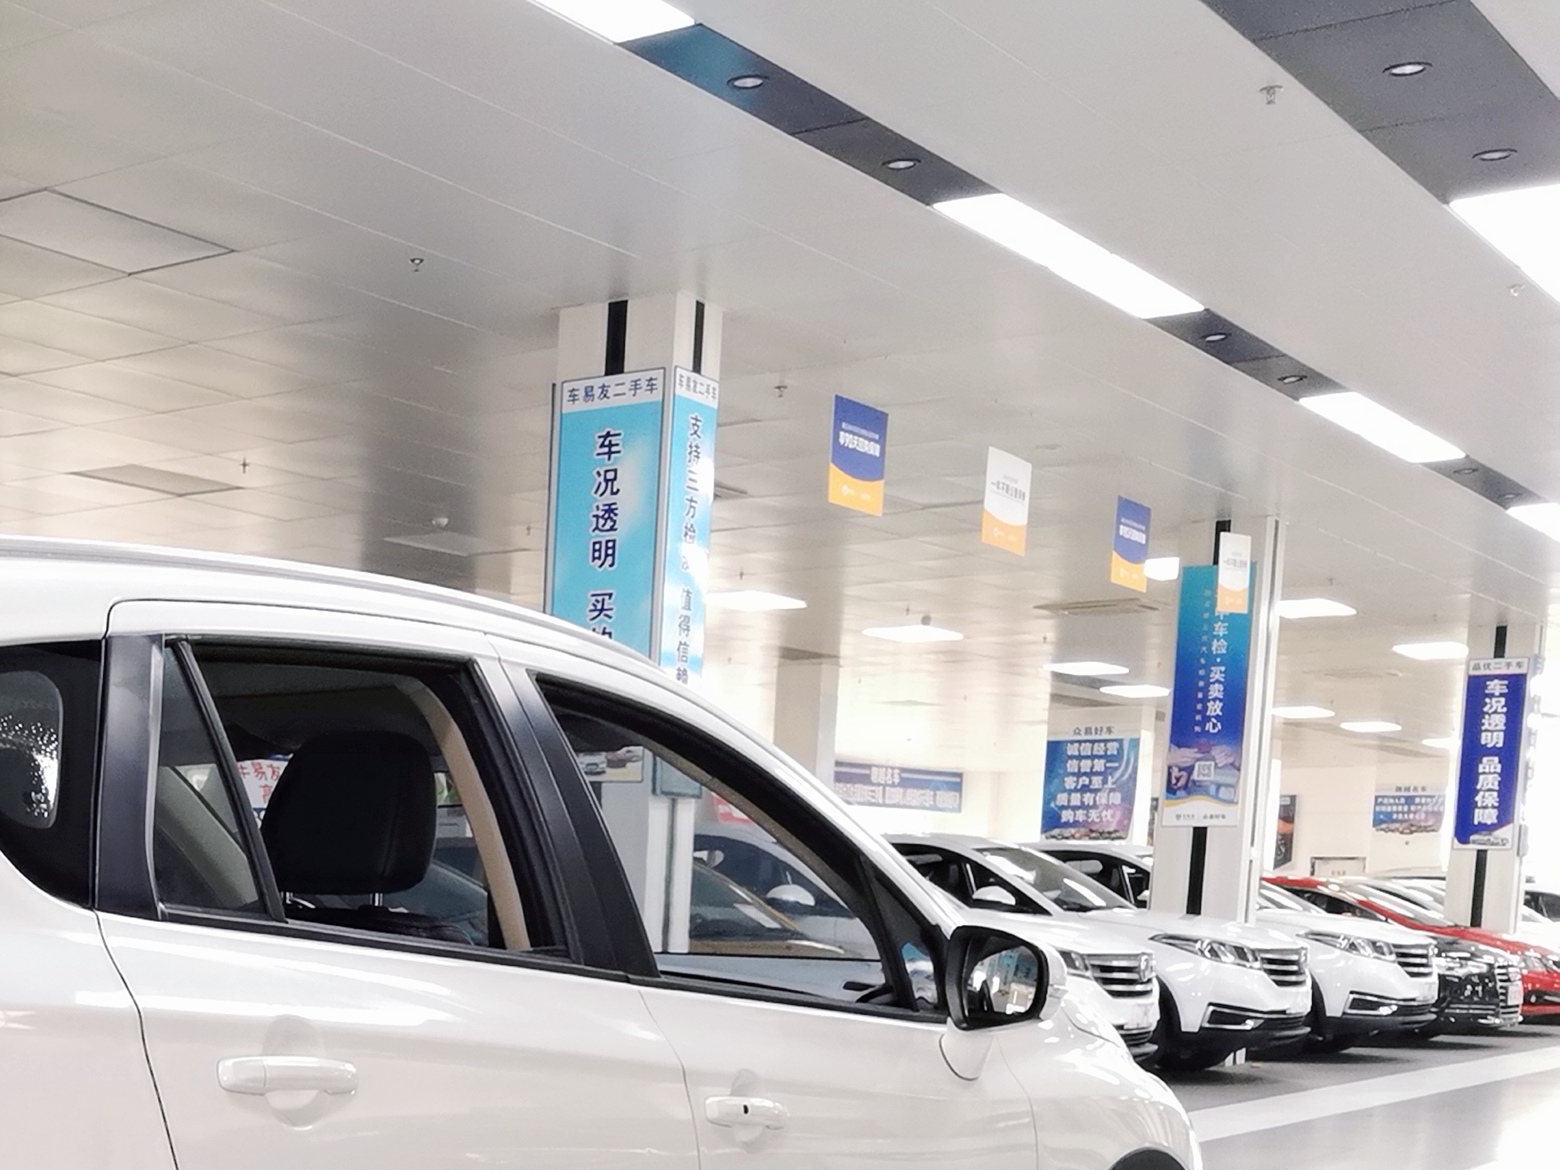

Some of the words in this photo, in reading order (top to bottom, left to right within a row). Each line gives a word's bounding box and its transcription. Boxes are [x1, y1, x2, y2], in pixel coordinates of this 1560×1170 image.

[567, 377, 659, 405] 车易友二手车
[591, 430, 622, 574] 车况透明
[1480, 679, 1509, 748] 车况透明
[1064, 775, 1117, 790] 客户至上
[1473, 756, 1502, 826] 品质保障
